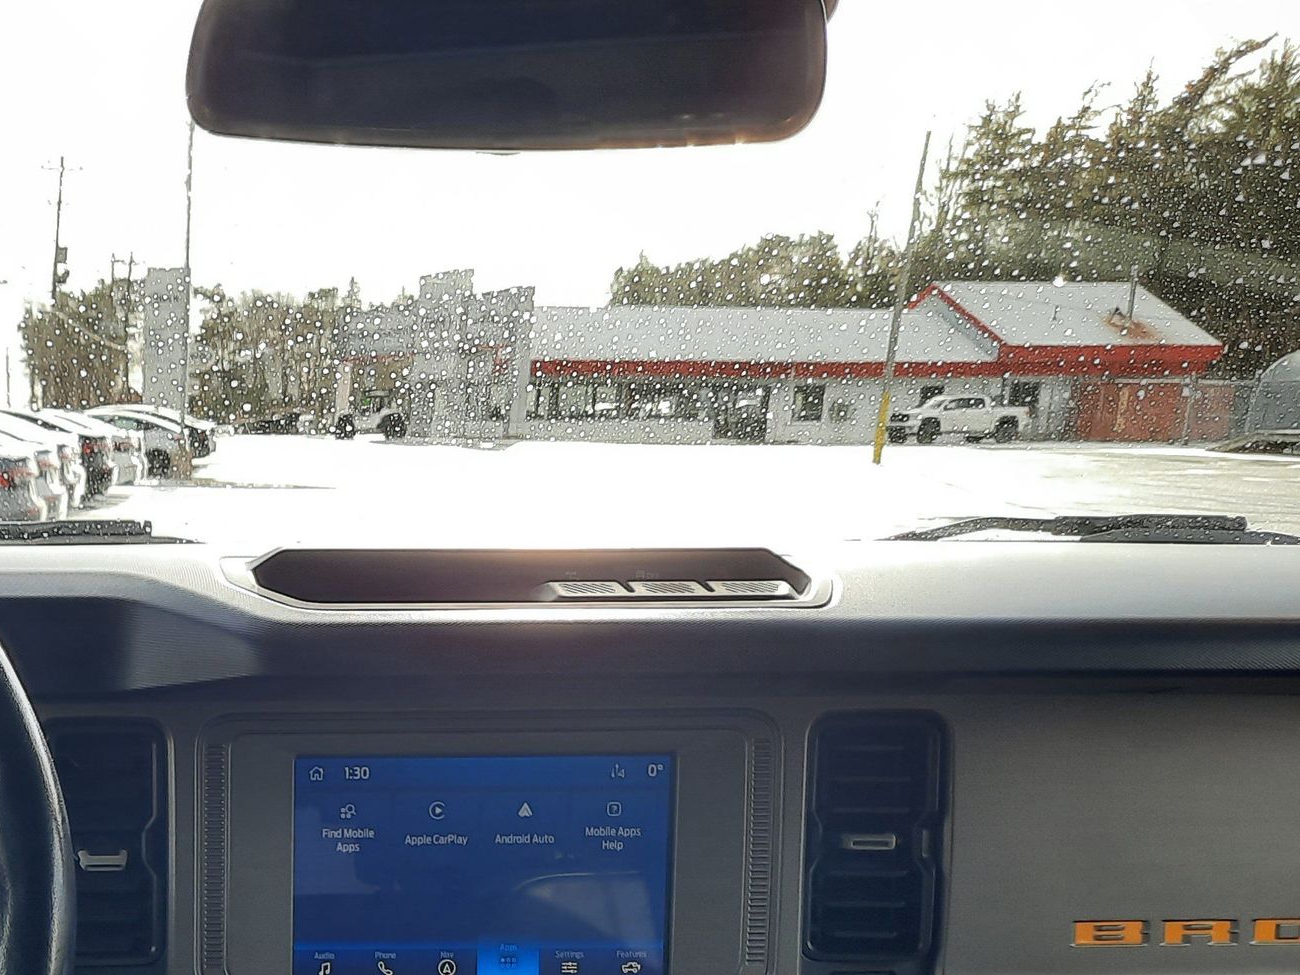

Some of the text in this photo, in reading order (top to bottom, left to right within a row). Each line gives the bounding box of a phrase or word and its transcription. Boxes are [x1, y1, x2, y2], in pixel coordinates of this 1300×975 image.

[344, 766, 370, 780] 1:30
[322, 828, 375, 839] Find Mobile
[585, 826, 642, 838] Mobile Apps
[404, 834, 468, 846] Apple CarPlay
[495, 833, 555, 844] Android Auto
[336, 842, 360, 853] Apps
[602, 840, 624, 851] Help
[314, 951, 335, 960] Audio
[374, 951, 397, 960] Phone
[440, 951, 454, 959] Nav
[555, 950, 585, 960] Settings
[616, 950, 647, 959] Features
